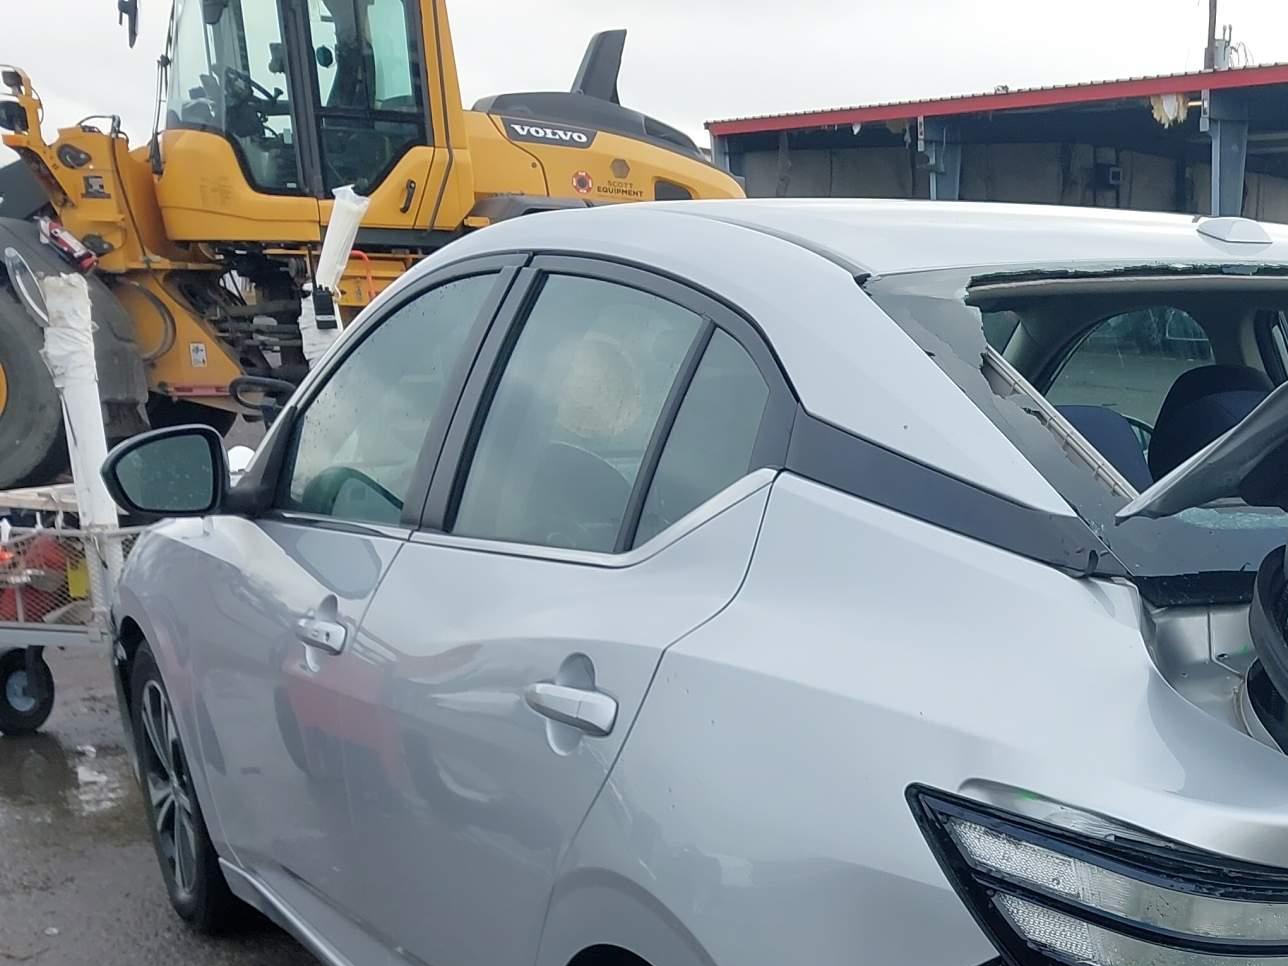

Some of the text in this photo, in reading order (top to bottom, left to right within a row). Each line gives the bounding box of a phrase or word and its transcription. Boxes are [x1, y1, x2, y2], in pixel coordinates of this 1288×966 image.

[511, 124, 588, 143] VOLVO
[607, 180, 633, 188] SCOTT
[597, 186, 644, 197] EQUIPMENT
